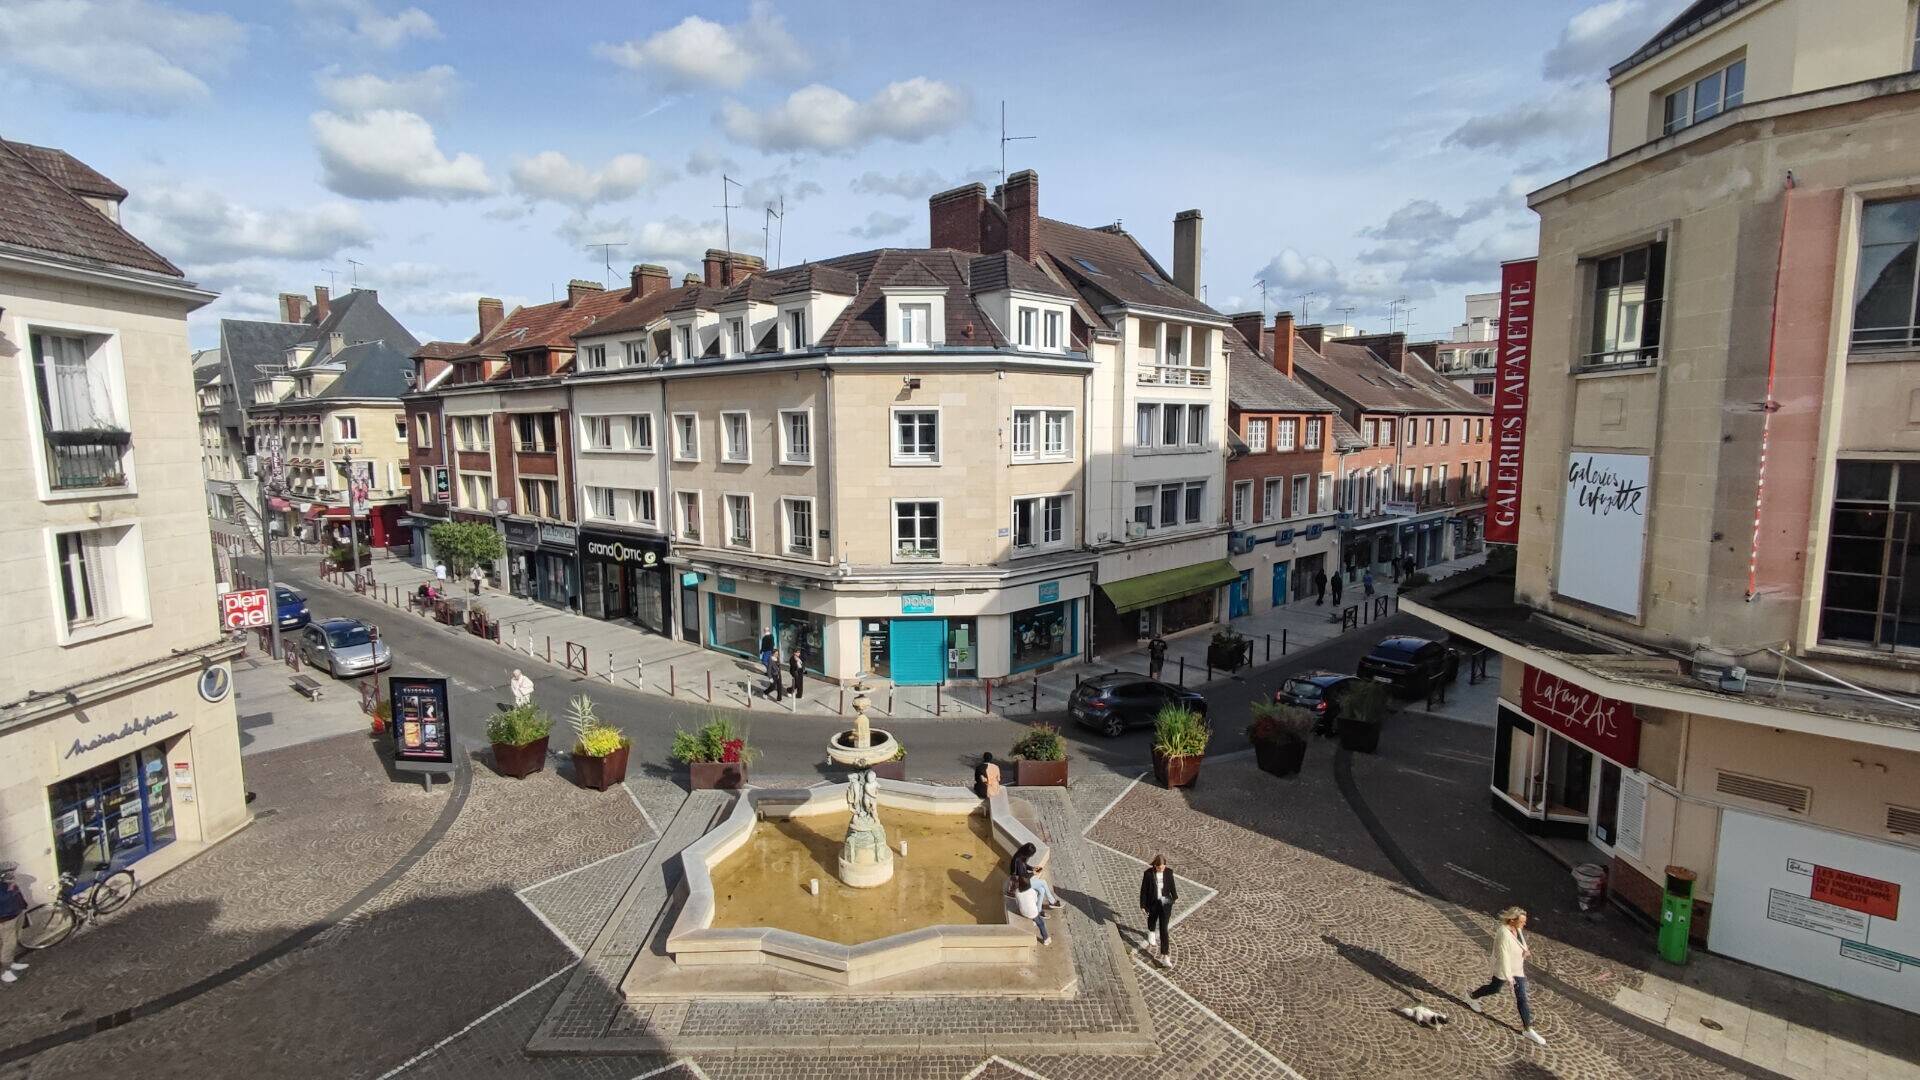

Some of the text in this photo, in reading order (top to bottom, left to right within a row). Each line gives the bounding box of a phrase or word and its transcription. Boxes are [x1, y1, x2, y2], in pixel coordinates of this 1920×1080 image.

[1494, 280, 1531, 527] GALERIES LAFAYETTE
[1568, 456, 1619, 489] Galeries
[1579, 479, 1649, 516] Lafayette
[225, 591, 268, 613] plein
[227, 604, 269, 628] ciel
